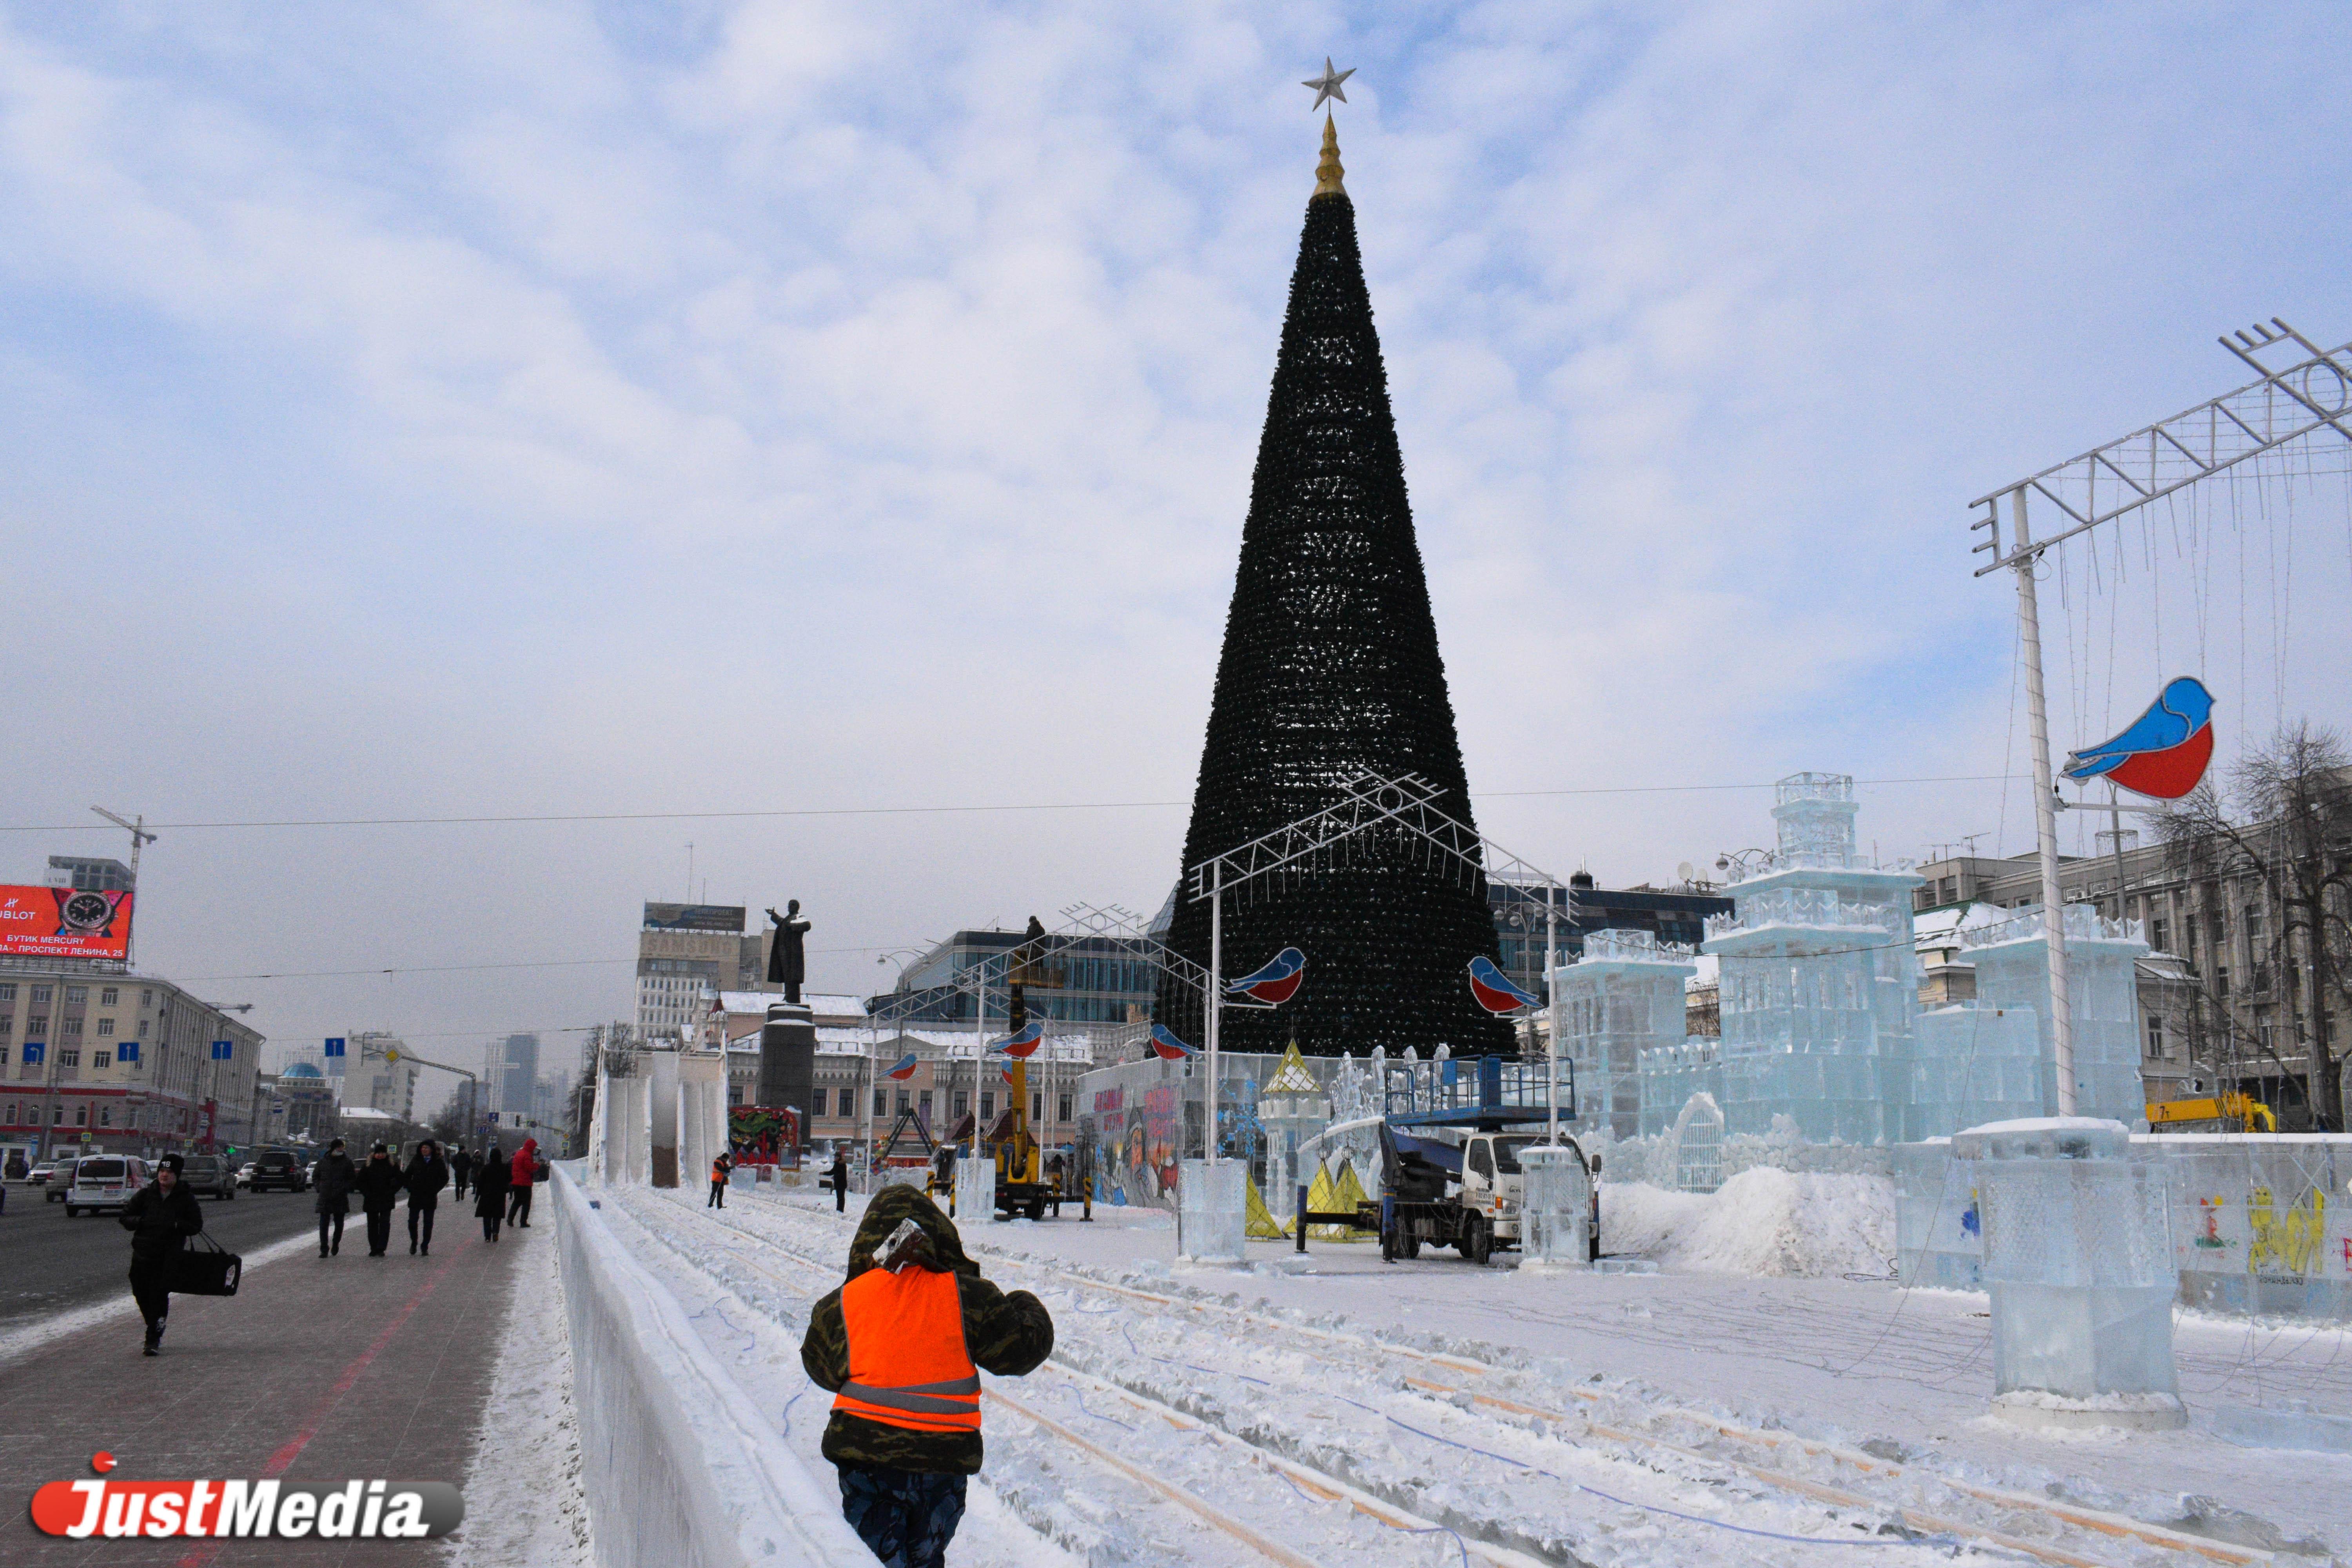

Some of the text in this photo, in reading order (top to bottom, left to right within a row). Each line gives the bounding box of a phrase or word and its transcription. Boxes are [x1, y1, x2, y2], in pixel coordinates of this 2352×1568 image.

[7, 935, 85, 945] БУТИК MERCURY
[18, 945, 69, 954] ПРОСПЕКТ
[70, 947, 110, 957] ЛЕНИНА,
